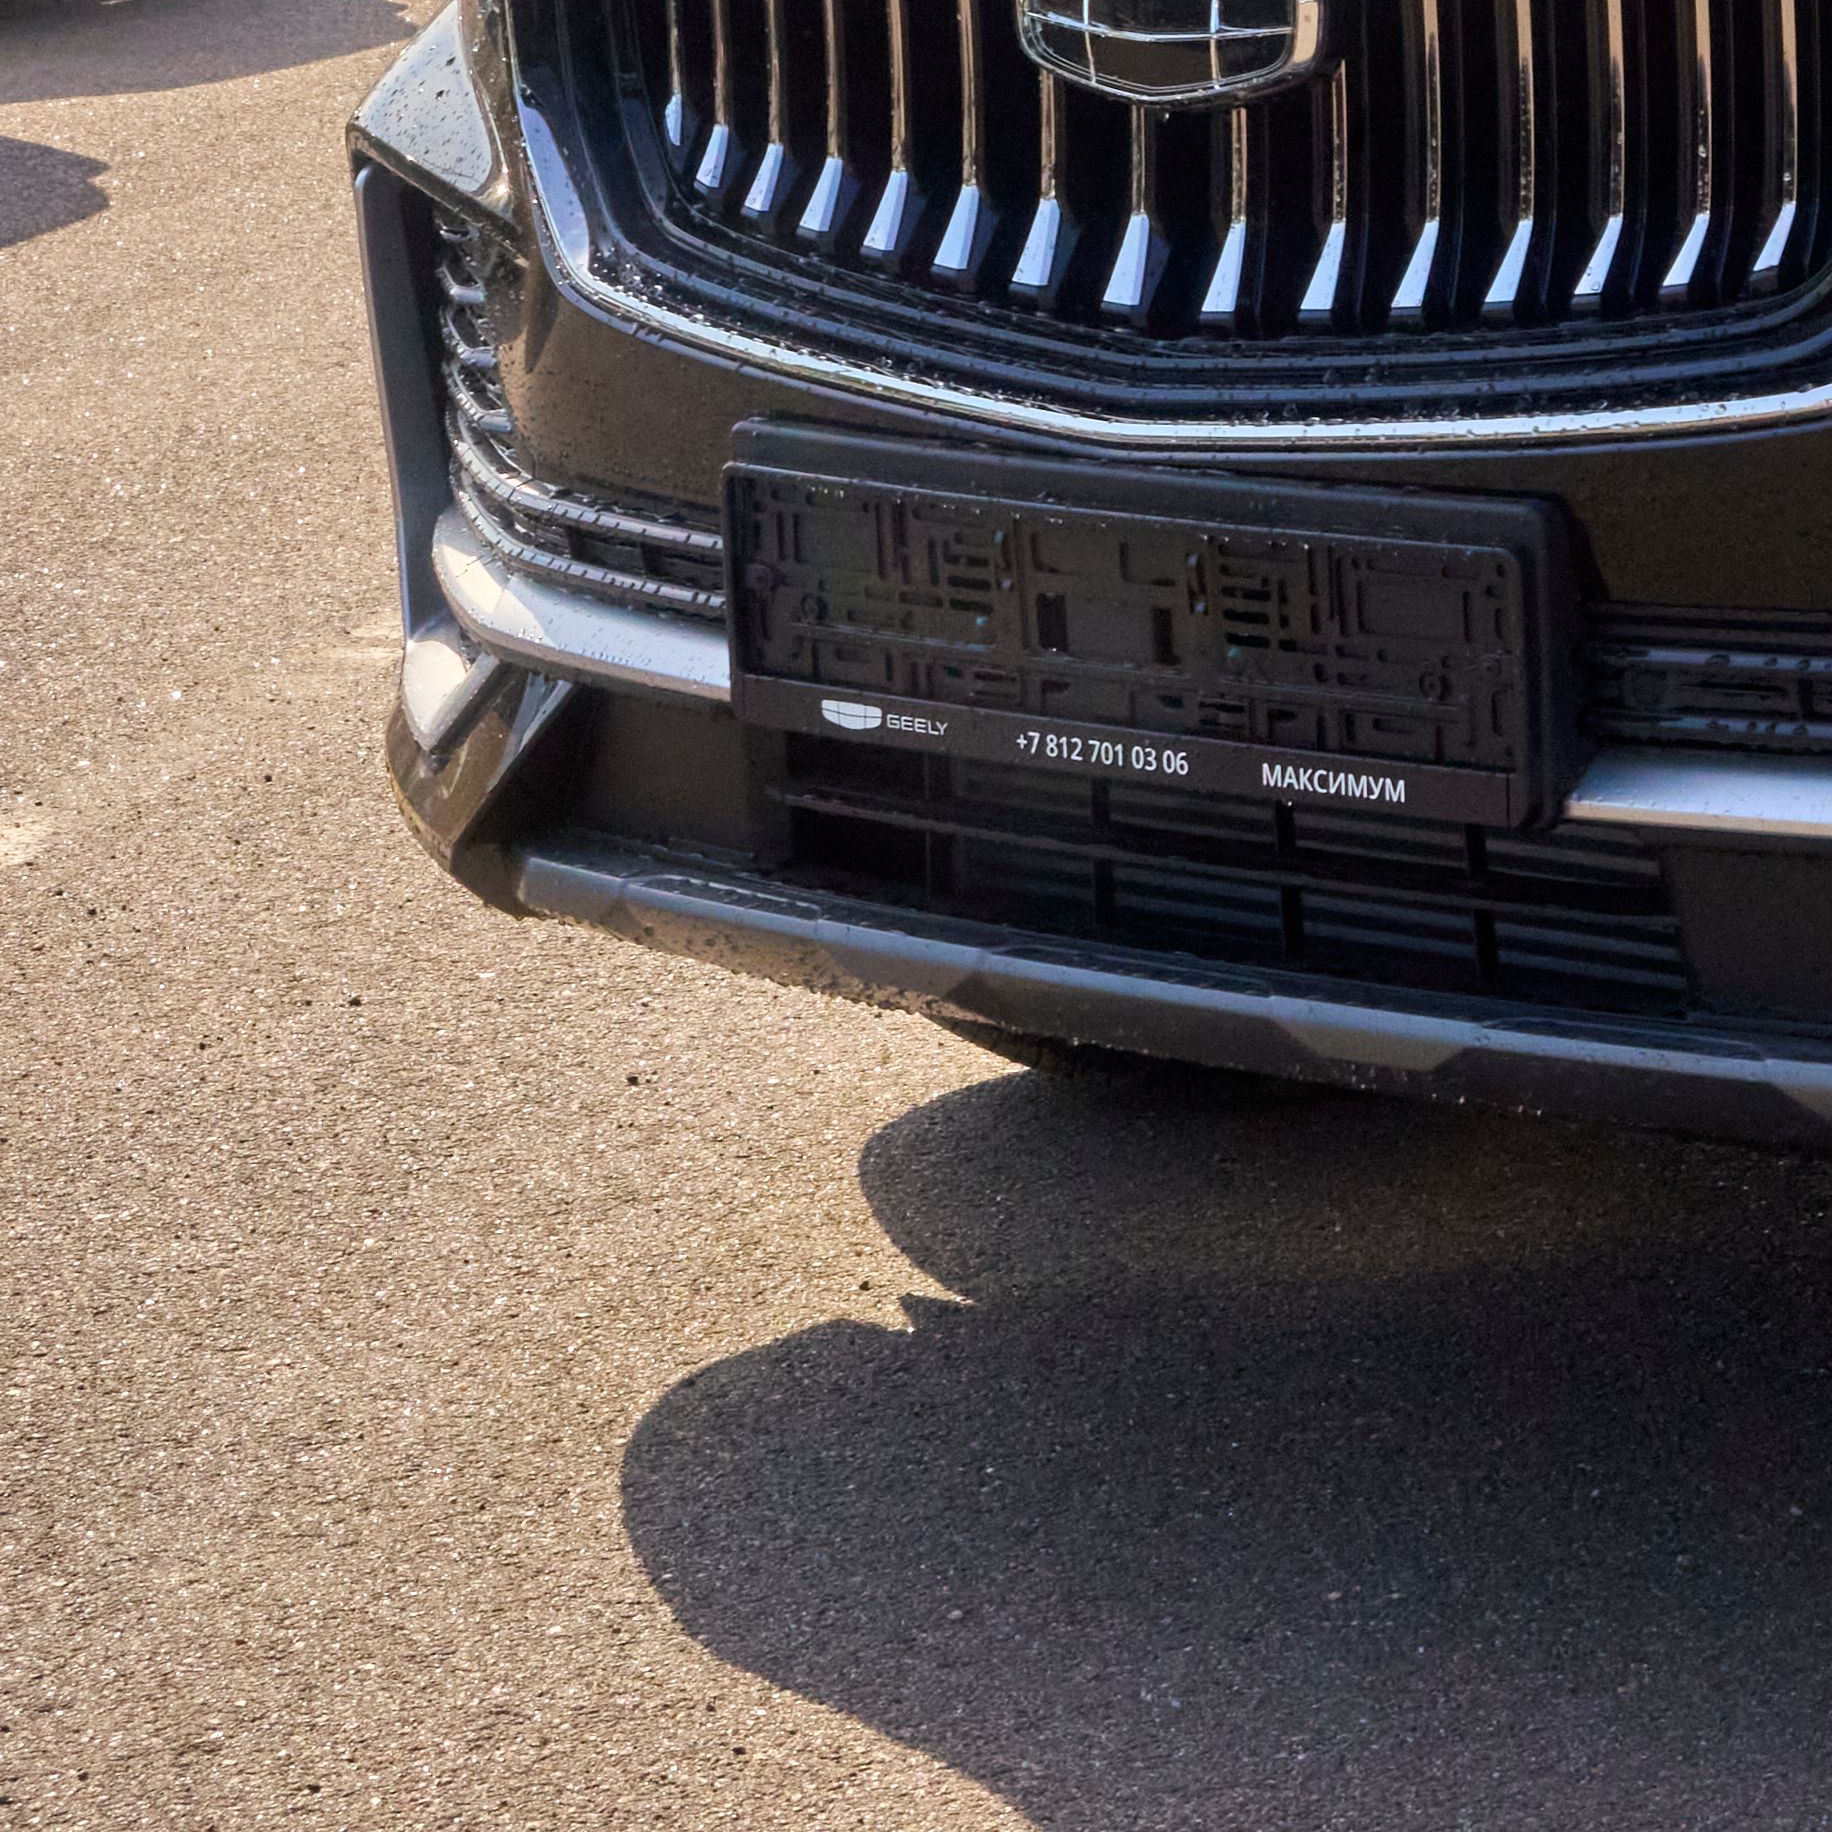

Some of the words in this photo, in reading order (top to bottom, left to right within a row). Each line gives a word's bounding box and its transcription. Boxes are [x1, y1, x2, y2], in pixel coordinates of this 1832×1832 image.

[886, 714, 948, 736] GEELY
[1016, 731, 1040, 755] +7
[1046, 735, 1083, 761] 812
[1087, 739, 1124, 766] 701
[1131, 746, 1157, 771] 03
[1162, 750, 1189, 775] 06
[1262, 763, 1406, 803] МАКСИМУМ
